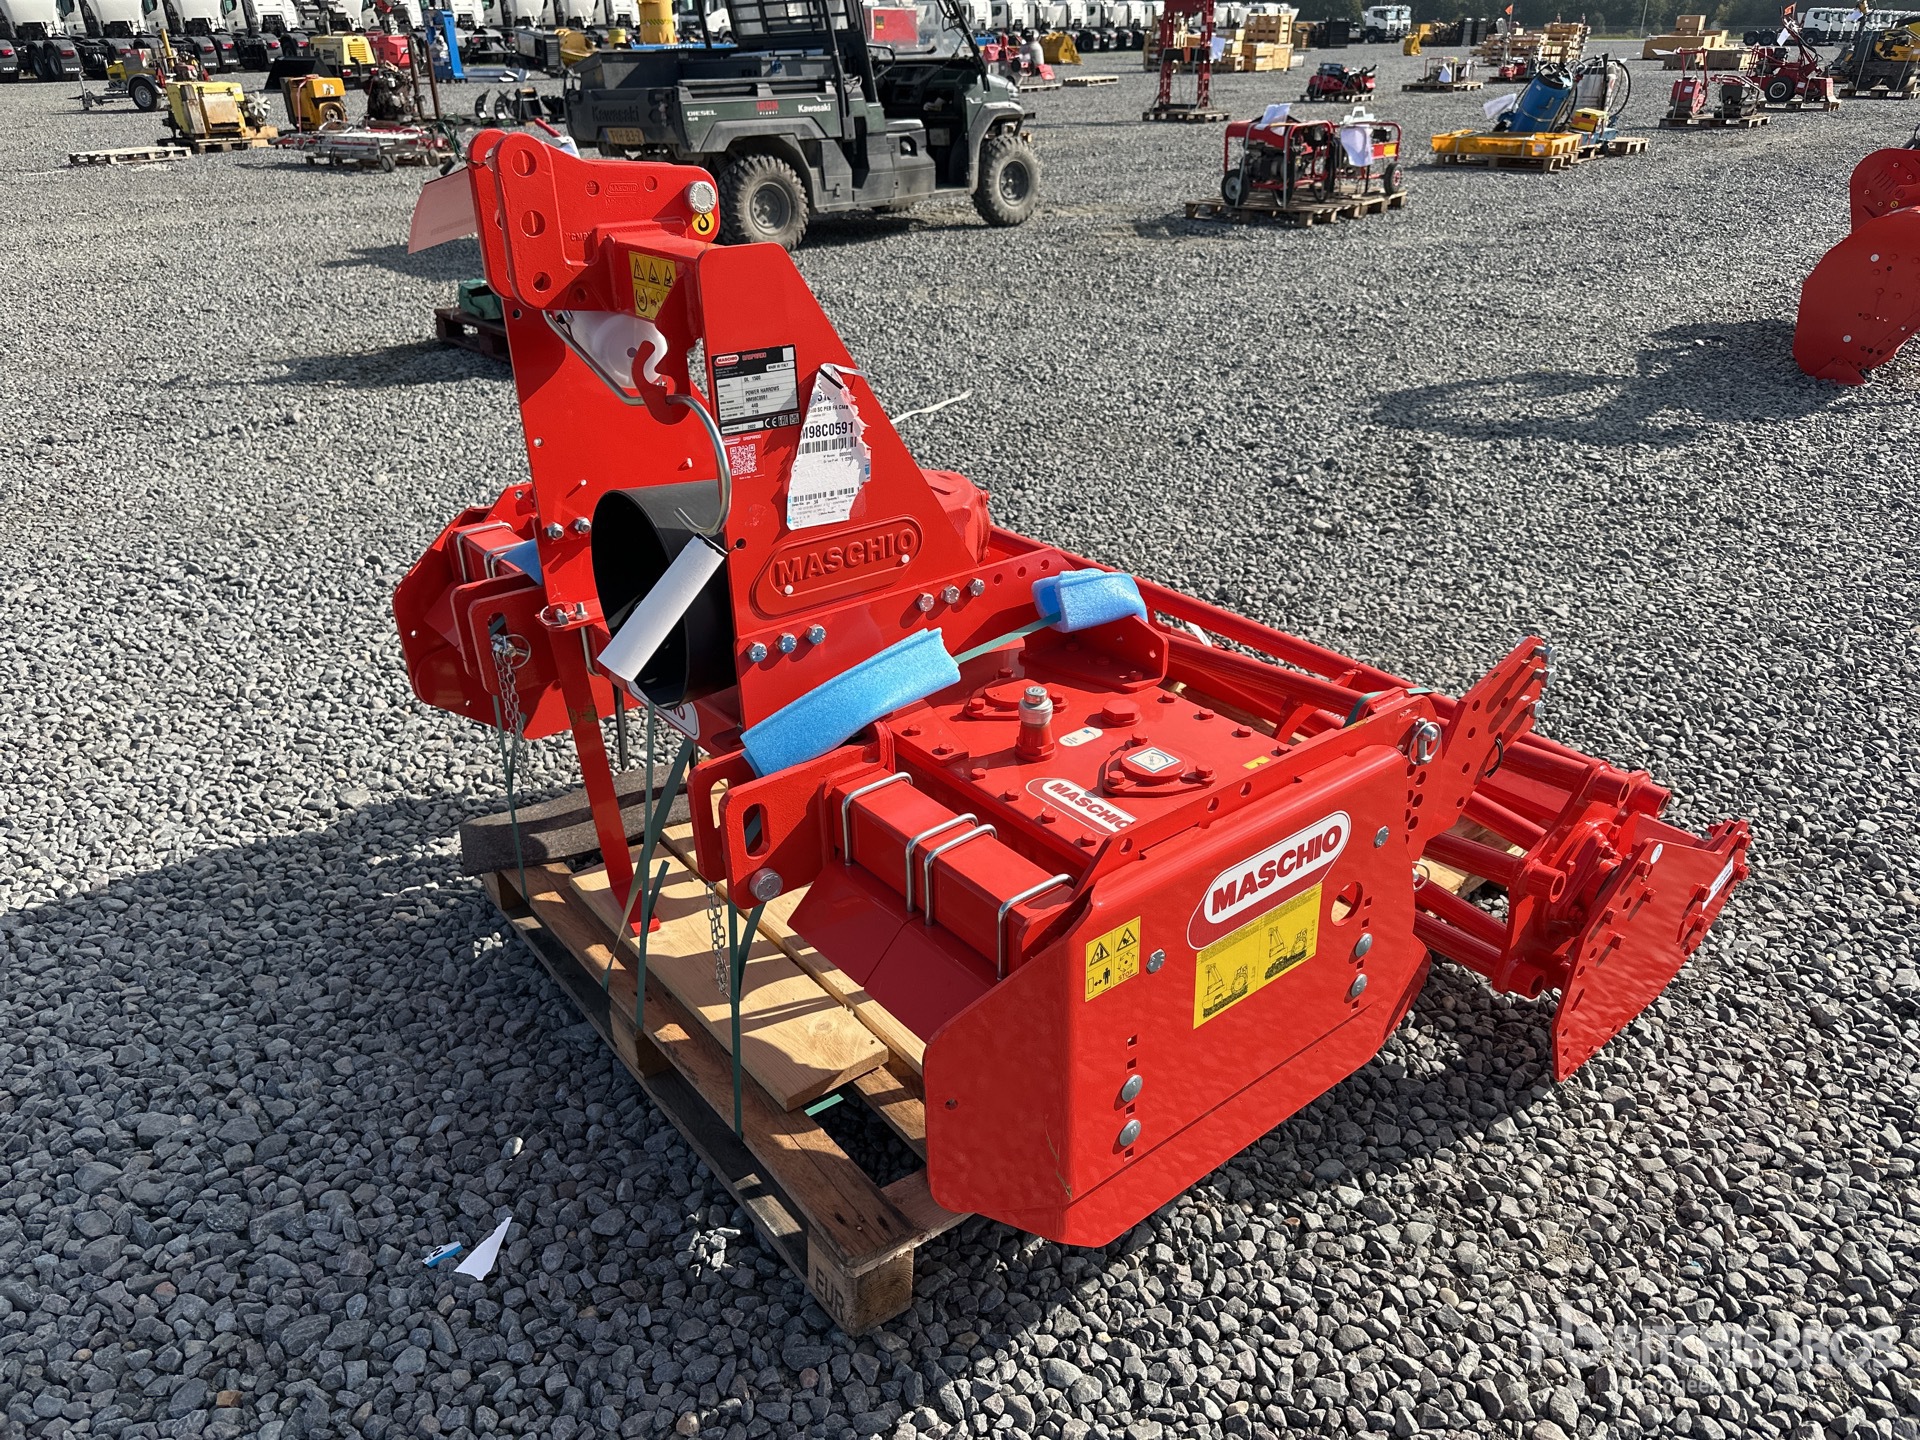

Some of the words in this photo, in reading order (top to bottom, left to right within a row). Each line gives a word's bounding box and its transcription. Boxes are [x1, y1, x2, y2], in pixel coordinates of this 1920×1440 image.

[756, 100, 779, 111] IRON
[798, 103, 831, 113] Kawasaki
[592, 106, 640, 122] Kawasaki
[745, 388, 760, 396] POWER
[761, 386, 780, 394] HARROWS
[774, 528, 918, 587] MASCHIO
[1048, 782, 1132, 829] MASCHIO
[1211, 825, 1342, 916] MASCHIO
[1118, 969, 1134, 981] STOP
[815, 1265, 844, 1322] EUR
